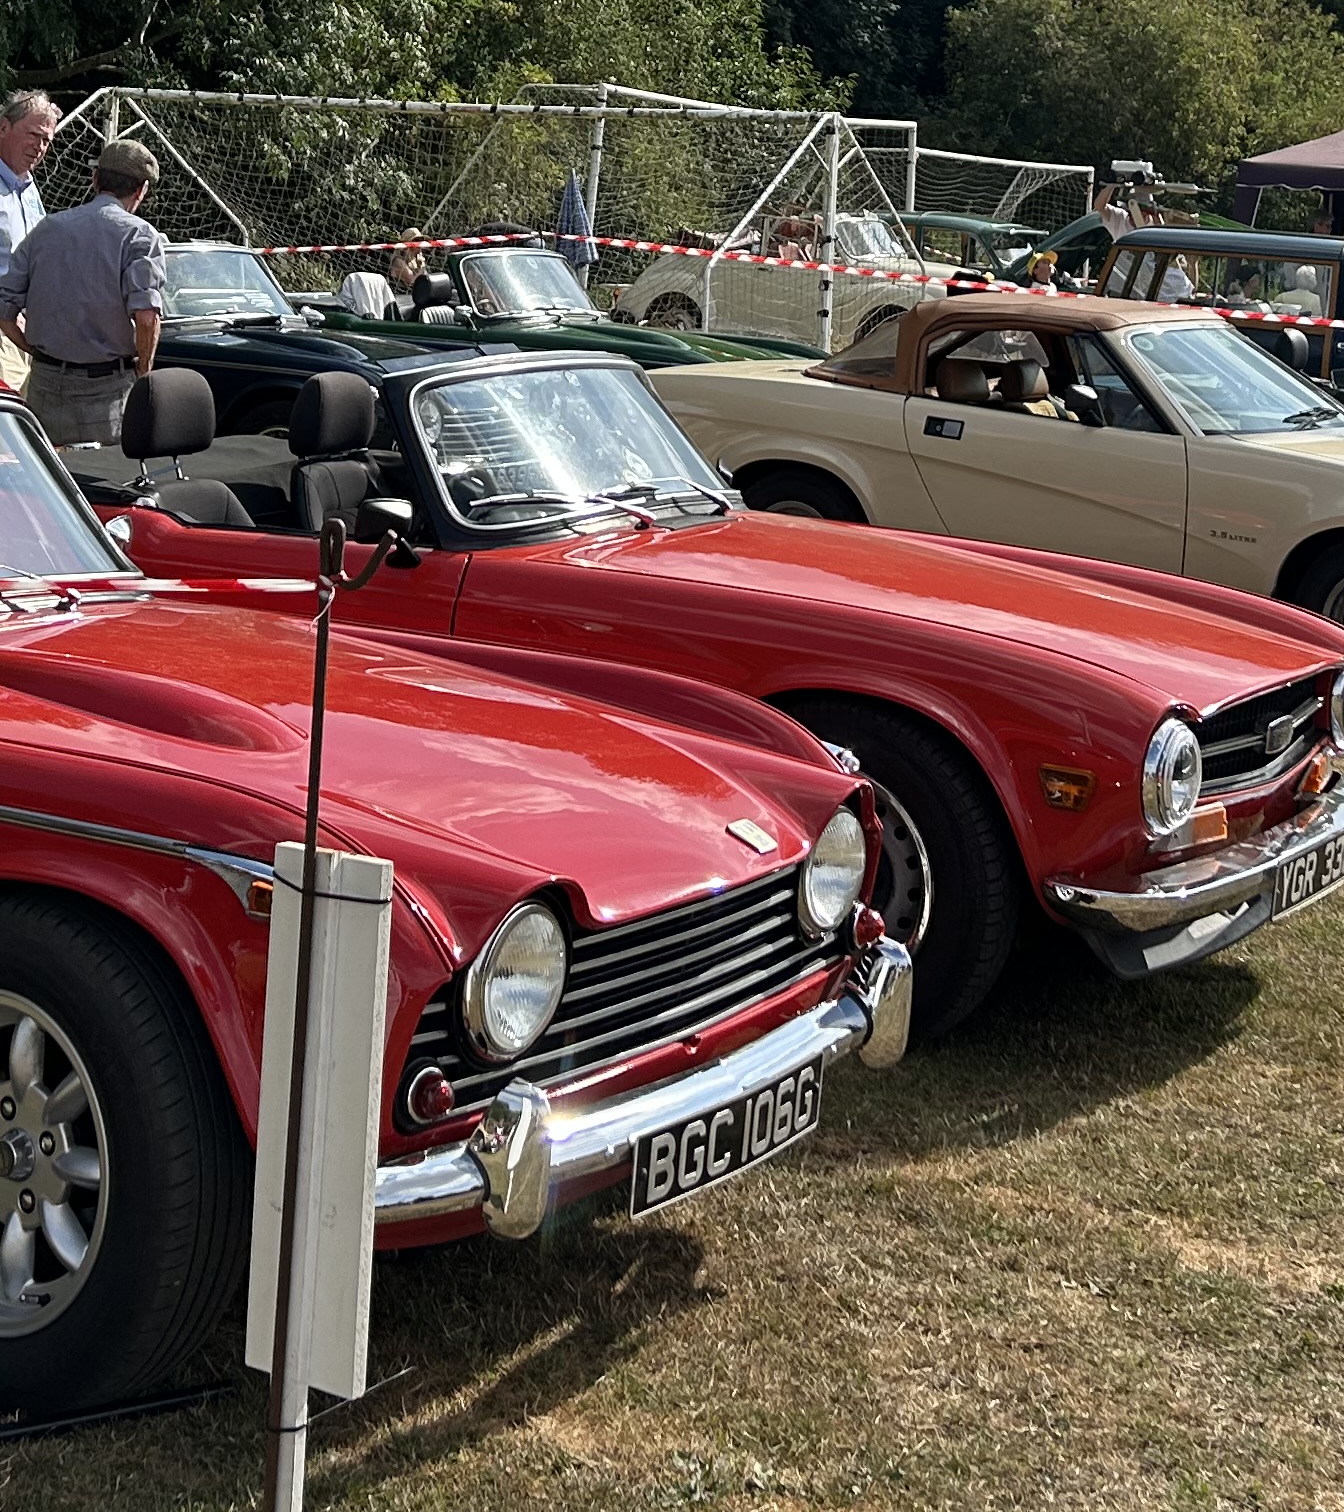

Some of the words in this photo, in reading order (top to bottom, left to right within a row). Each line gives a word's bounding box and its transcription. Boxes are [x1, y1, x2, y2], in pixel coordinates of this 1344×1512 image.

[1281, 851, 1318, 908] YGR
[646, 1108, 735, 1205] BGC
[741, 1066, 815, 1164] 106G
